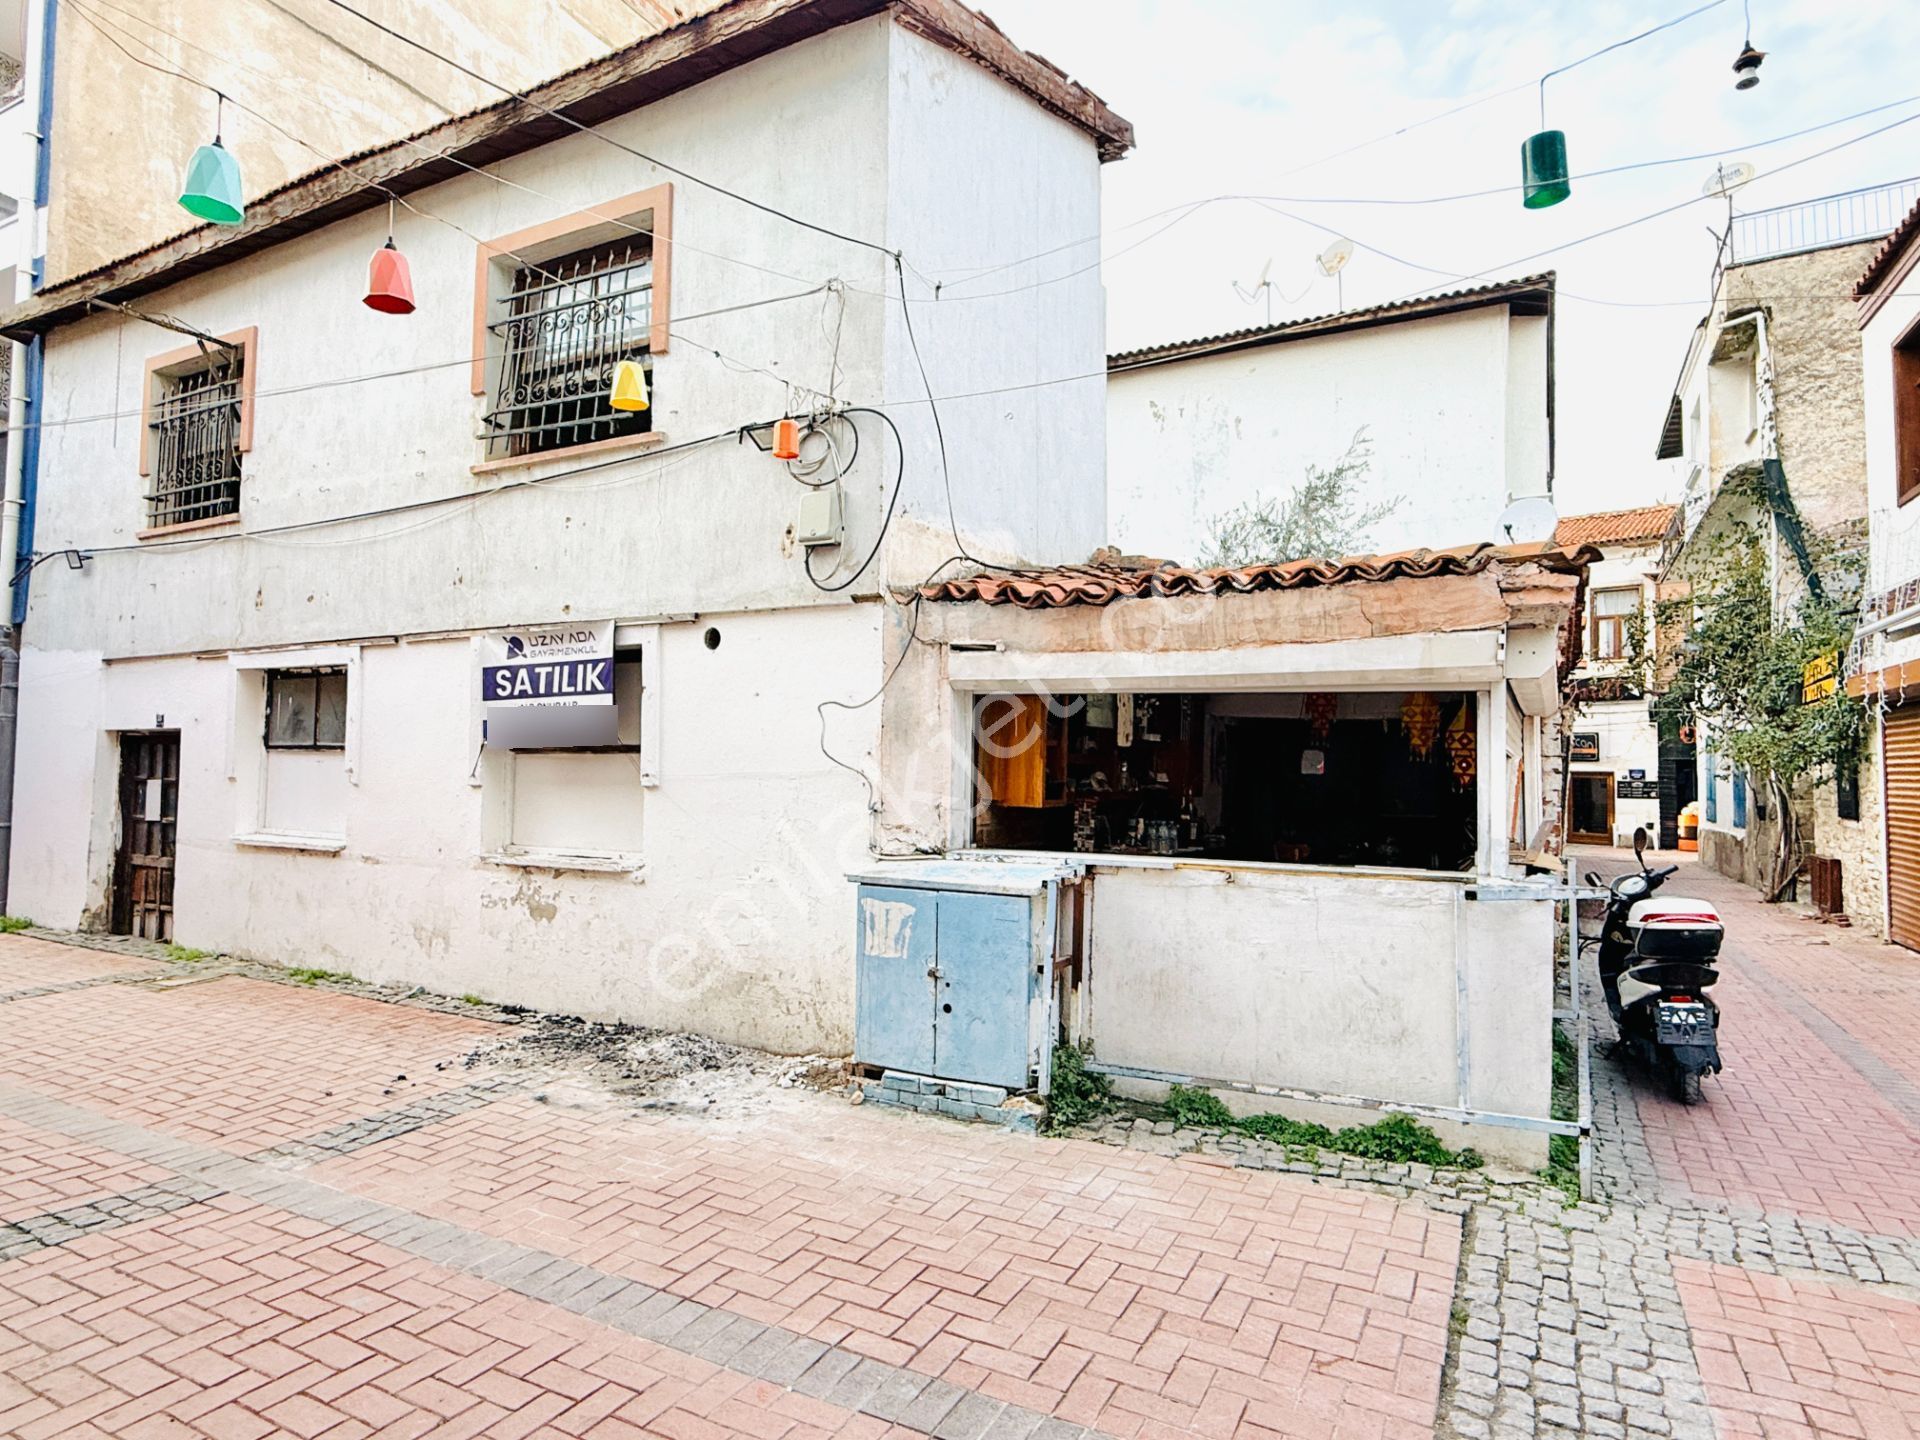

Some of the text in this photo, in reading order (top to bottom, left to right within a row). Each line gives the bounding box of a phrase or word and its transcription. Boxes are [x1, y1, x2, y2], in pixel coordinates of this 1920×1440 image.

[528, 630, 596, 647] UZAY ADA
[495, 662, 607, 697] SATILIK
